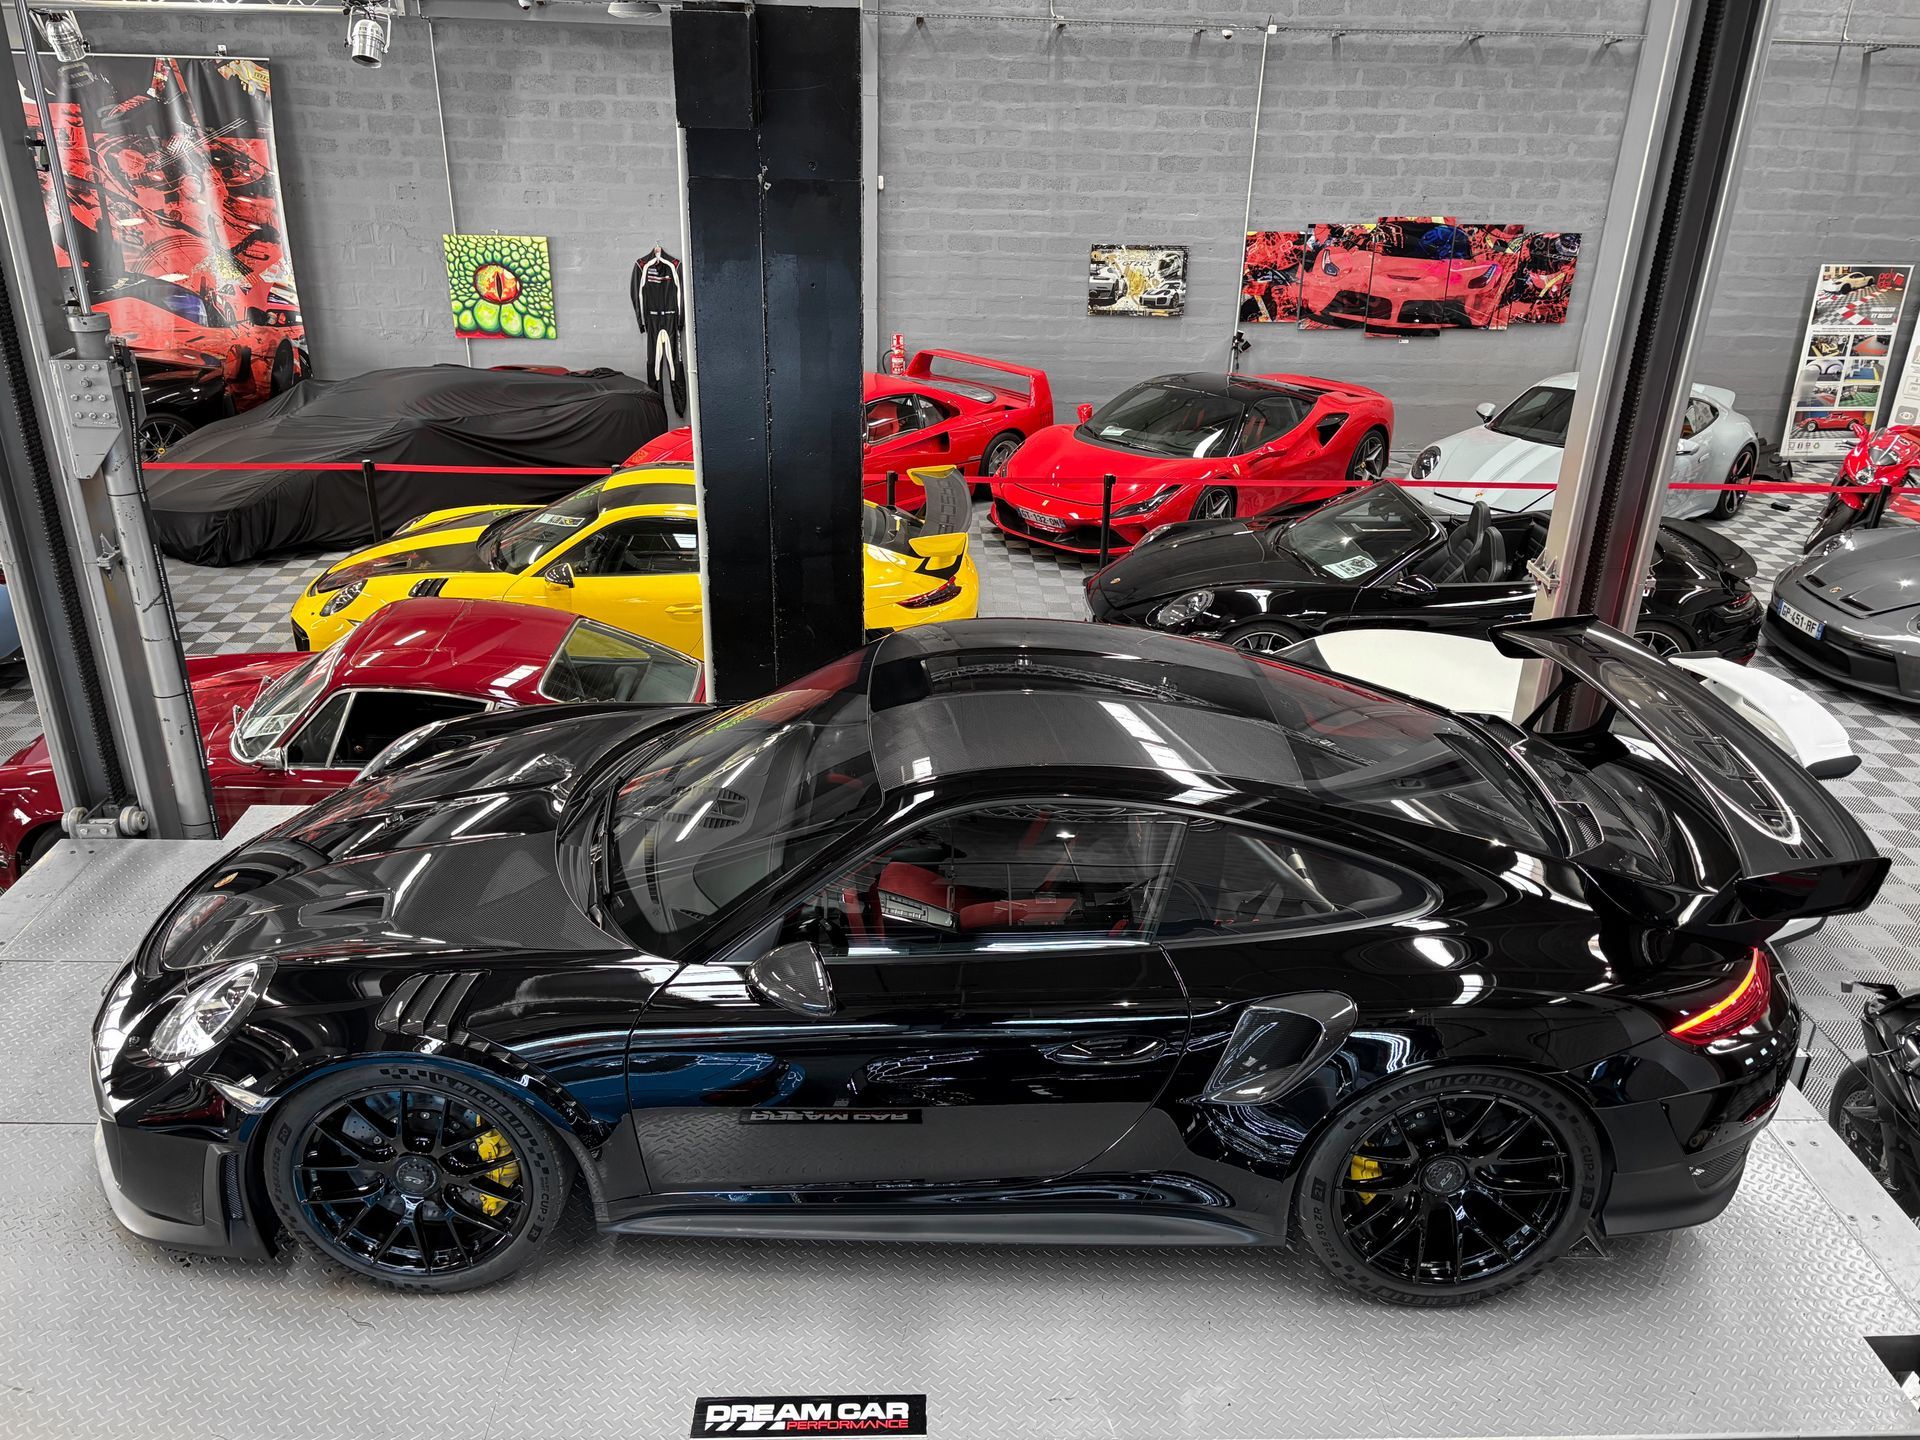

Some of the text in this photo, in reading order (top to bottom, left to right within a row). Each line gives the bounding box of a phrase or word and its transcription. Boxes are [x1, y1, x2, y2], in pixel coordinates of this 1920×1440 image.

[1781, 604, 1817, 633] GP-451-RF
[1425, 1075, 1533, 1096] MICHELIN
[453, 1081, 529, 1139] MICHELIN
[540, 1193, 550, 1214] CUP
[705, 1402, 909, 1422] DREAM CAR
[786, 1419, 909, 1430] PERFORMANCE
